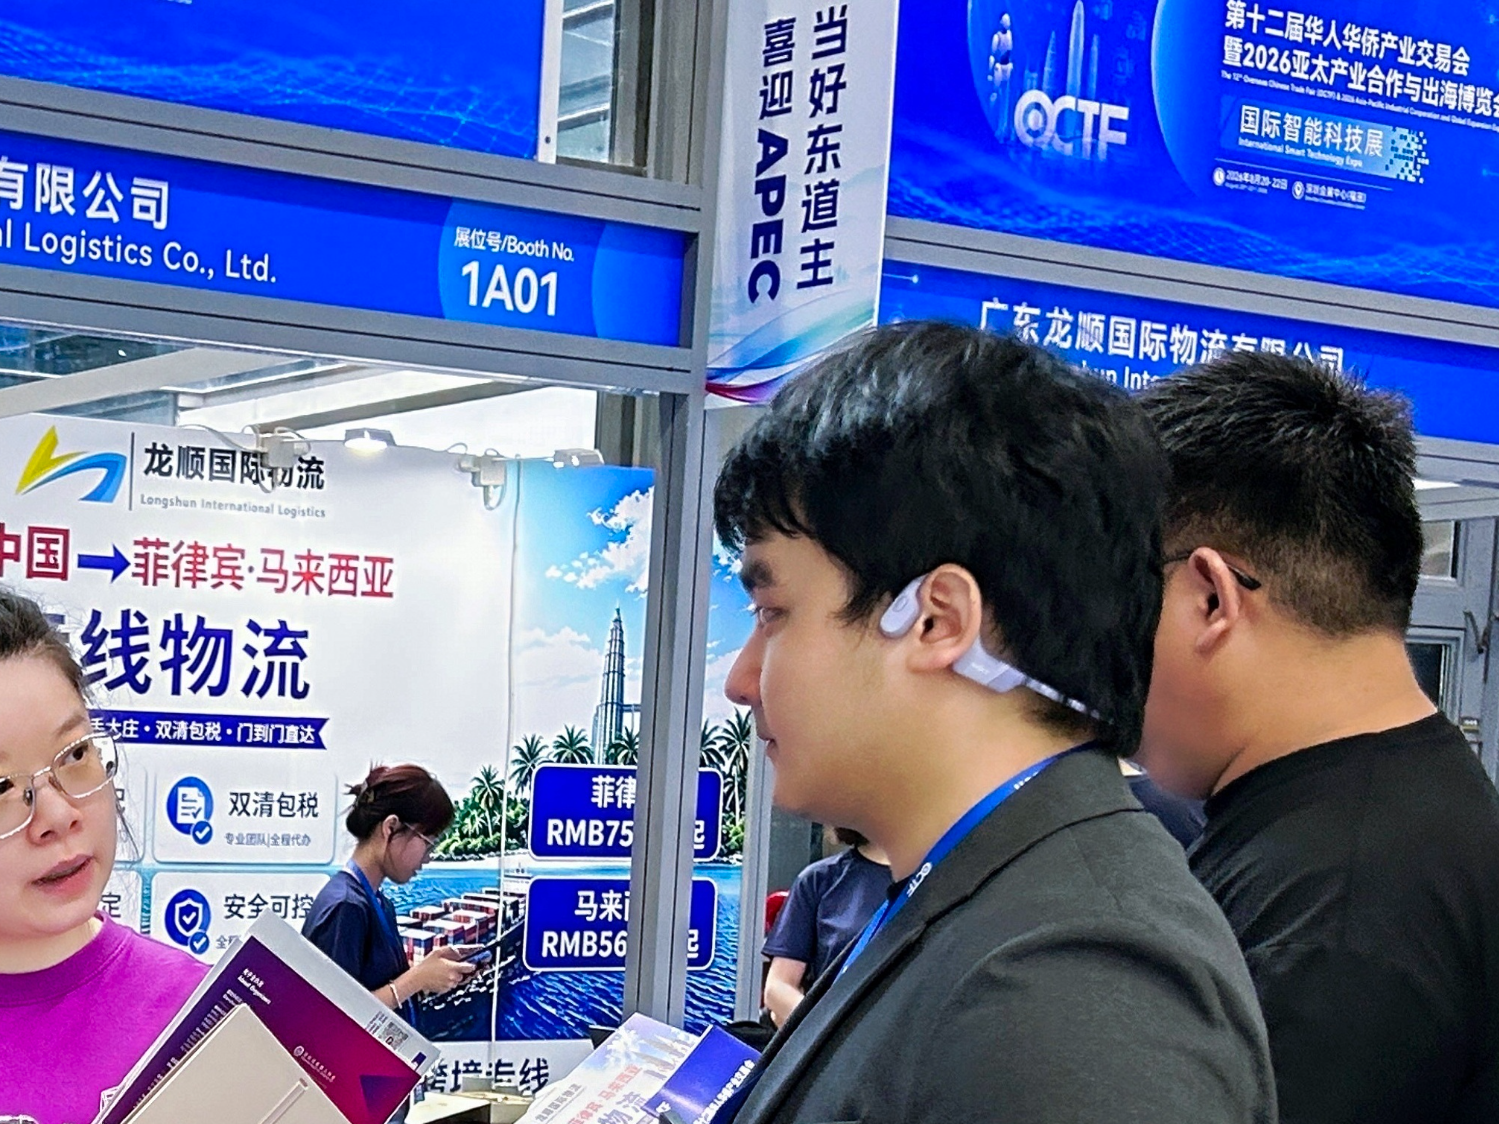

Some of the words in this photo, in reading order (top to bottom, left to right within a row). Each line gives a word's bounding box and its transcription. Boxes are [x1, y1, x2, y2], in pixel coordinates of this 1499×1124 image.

[759, 17, 796, 120] 喜迎
[1225, 0, 1471, 76] 第十二届华人华侨产业交易会
[797, 4, 848, 290] 当好东道主
[1014, 89, 1130, 160] OCTF
[1239, 104, 1383, 158] 国际智能科技展
[454, 226, 549, 259] 展位号/Booth
[552, 241, 575, 263] No.
[748, 128, 789, 304] APEC
[24, 221, 154, 265] Logistics
[163, 241, 215, 280] Co.,
[225, 249, 277, 284] Ltd.
[461, 260, 559, 316] 1A01
[140, 493, 197, 509] Longshun
[201, 497, 274, 515] International
[278, 502, 327, 519] Logistics
[132, 537, 396, 599] 菲律宾·马来西亚
[48, 607, 310, 700] 线物流
[228, 791, 319, 818] 双清包税
[224, 893, 314, 919] 安全可控
[574, 889, 632, 923] 马来
